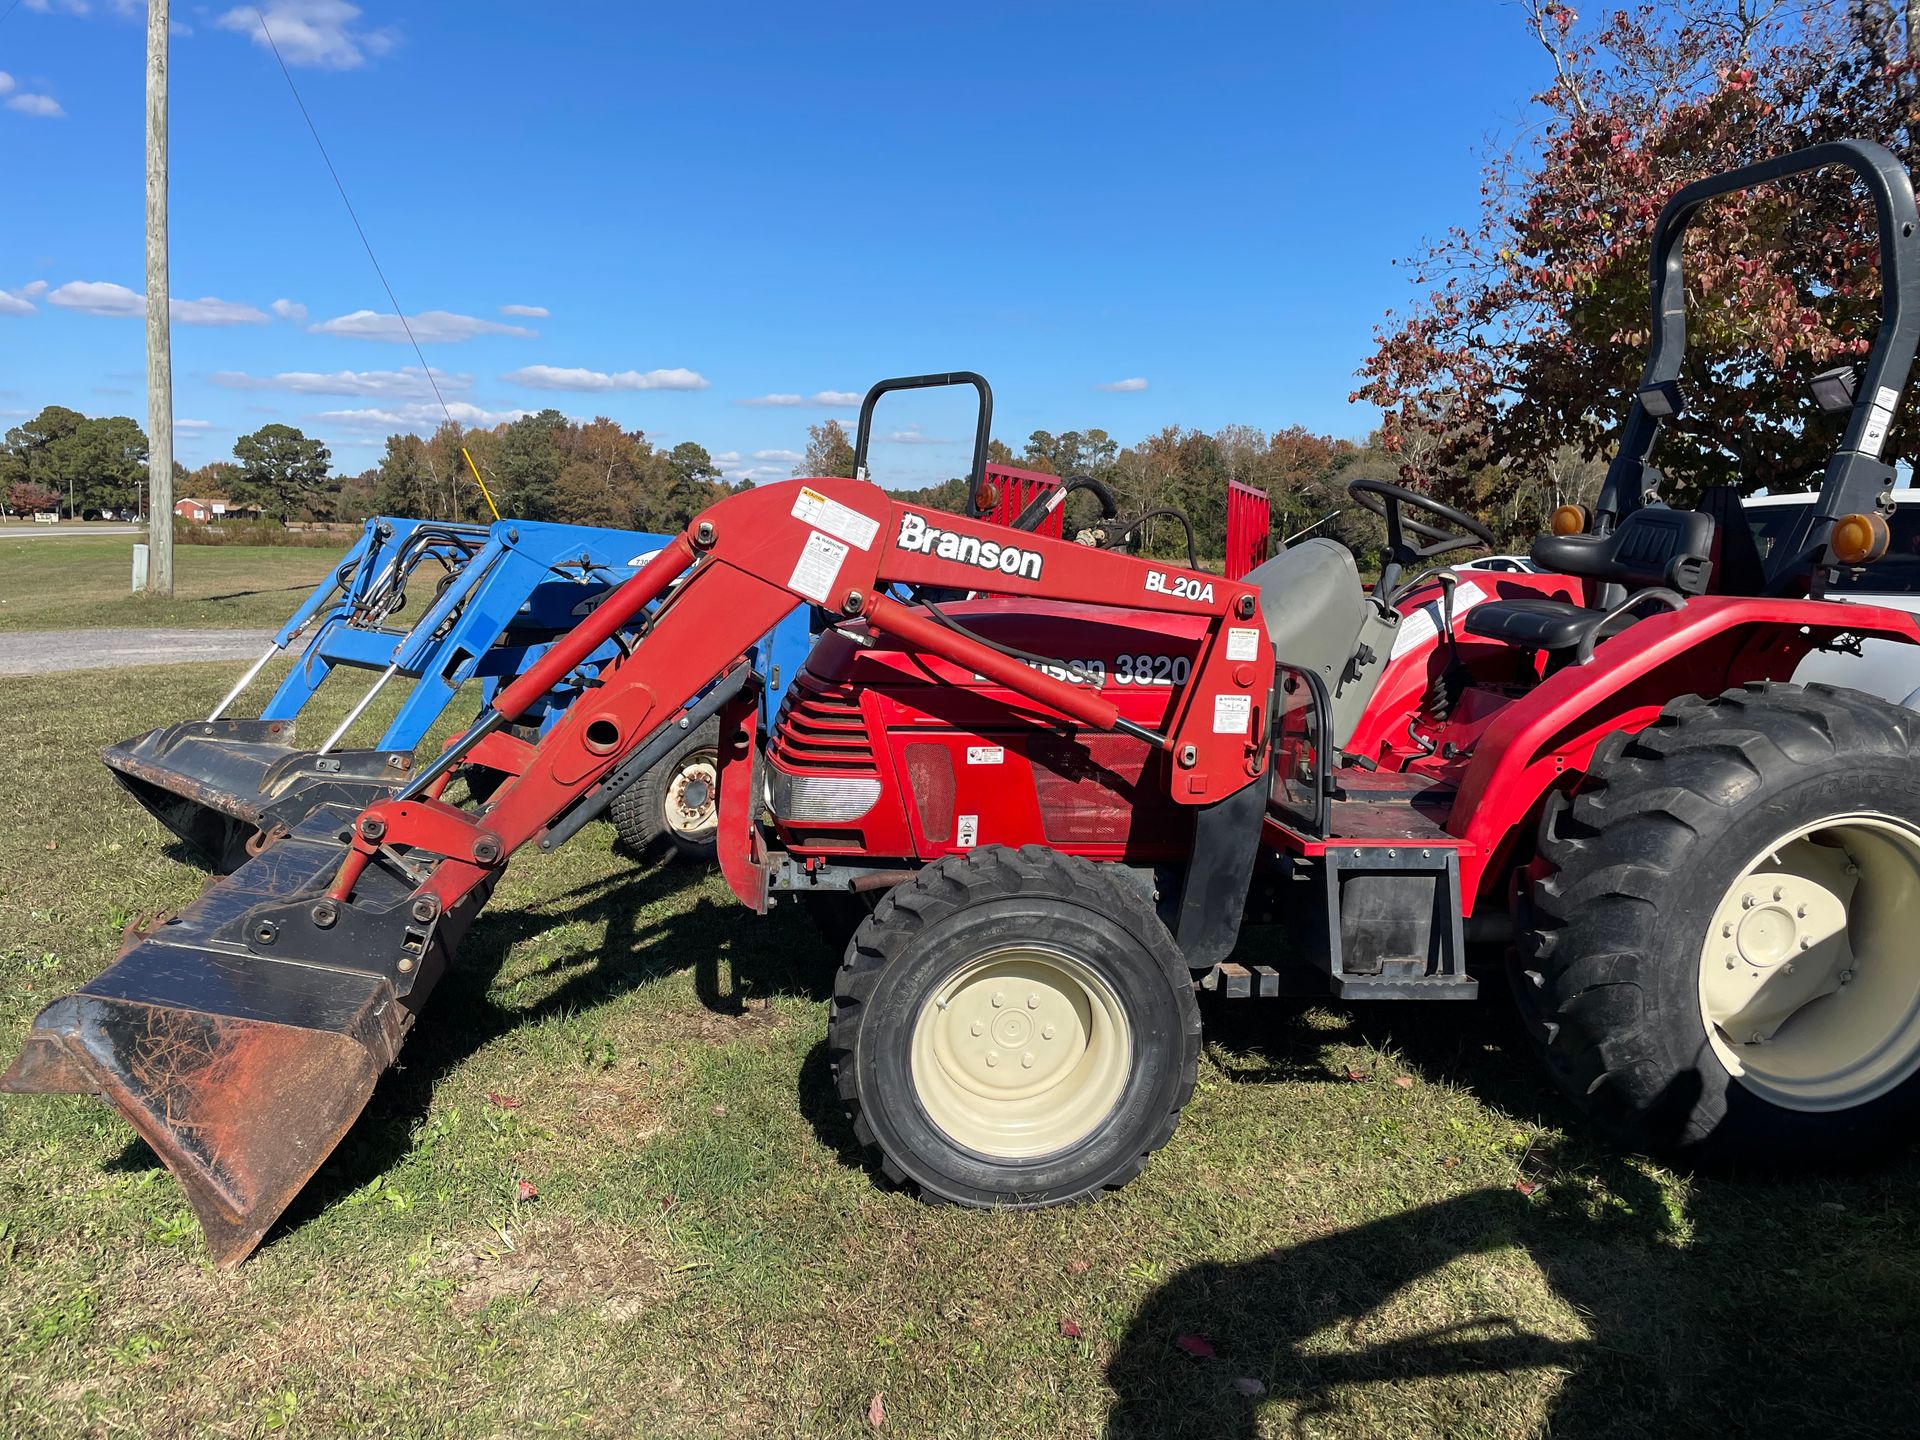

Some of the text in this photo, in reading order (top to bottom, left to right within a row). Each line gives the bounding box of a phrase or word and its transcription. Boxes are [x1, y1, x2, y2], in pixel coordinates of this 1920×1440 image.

[897, 511, 1043, 581] Branson
[1144, 569, 1214, 604] BL20A
[1115, 654, 1191, 685] 3820
